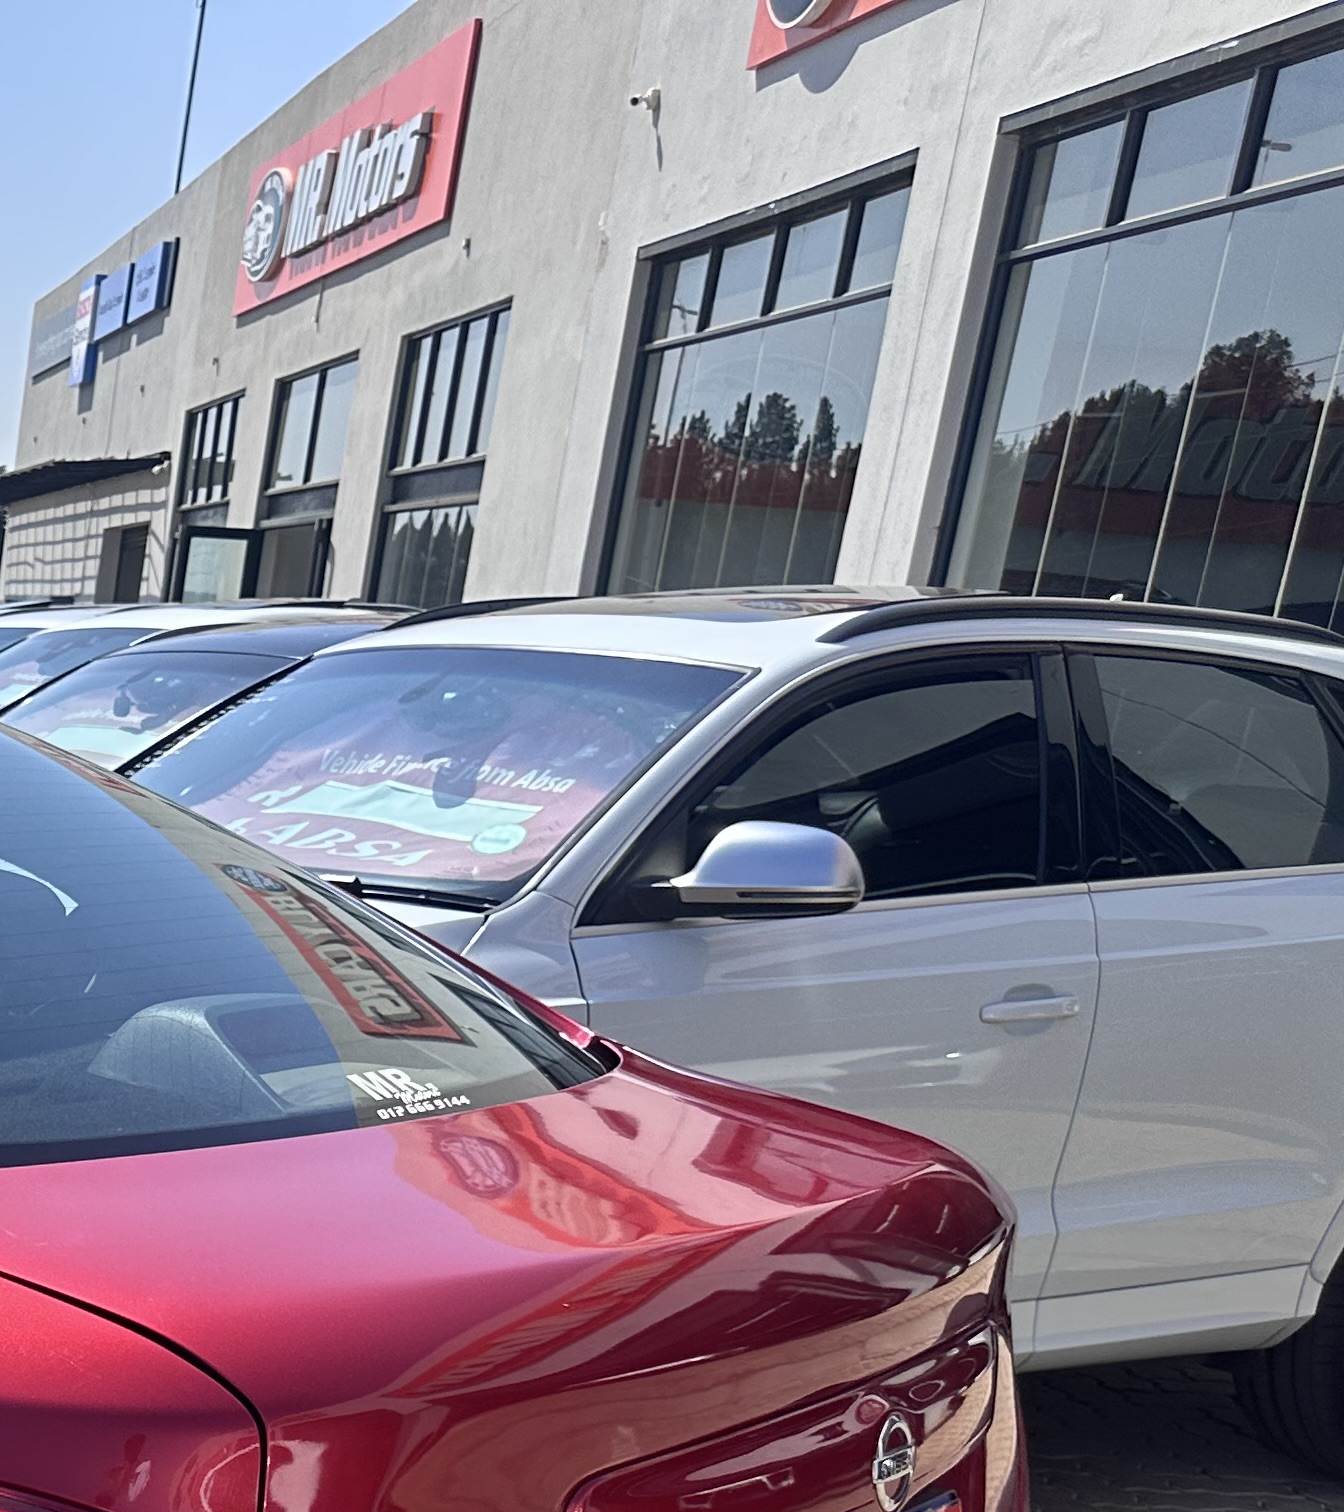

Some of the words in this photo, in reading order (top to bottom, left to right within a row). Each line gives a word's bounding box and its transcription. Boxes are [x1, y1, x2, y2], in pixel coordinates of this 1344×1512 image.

[323, 110, 432, 238] Motors
[511, 768, 577, 794] Absa
[262, 820, 434, 867] ABSA
[433, 1094, 471, 1110] 9144
